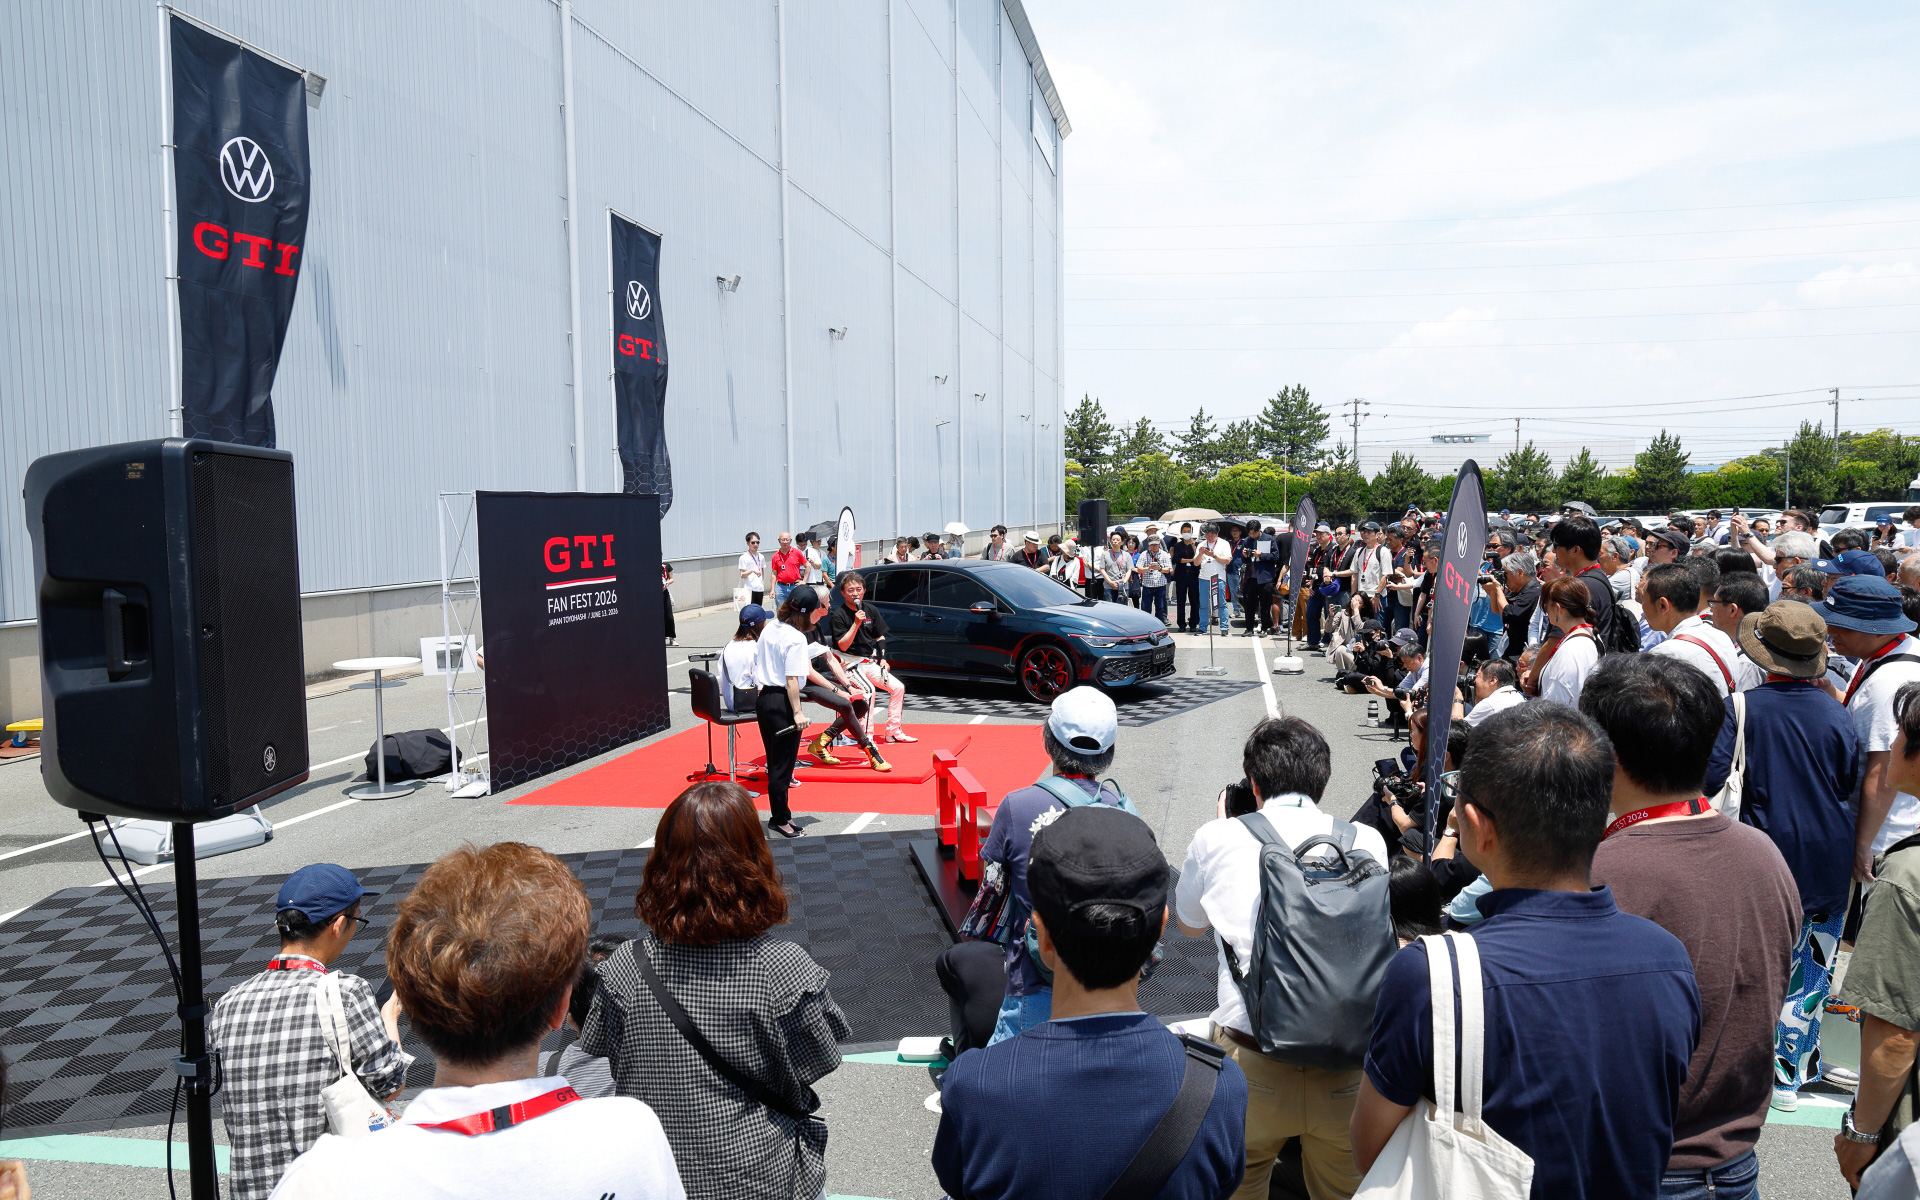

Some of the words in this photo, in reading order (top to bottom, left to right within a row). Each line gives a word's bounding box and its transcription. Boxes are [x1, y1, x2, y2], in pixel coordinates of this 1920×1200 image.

[193, 222, 299, 276] GTI
[618, 334, 660, 363] GT
[543, 534, 616, 573] GTI
[1444, 562, 1471, 605] GTI
[547, 596, 568, 614] FAN
[570, 592, 593, 610] FEST
[594, 589, 618, 607] 2026
[548, 617, 563, 627] JAPAN
[1626, 811, 1649, 823] 2026
[556, 1089, 579, 1102] GT
